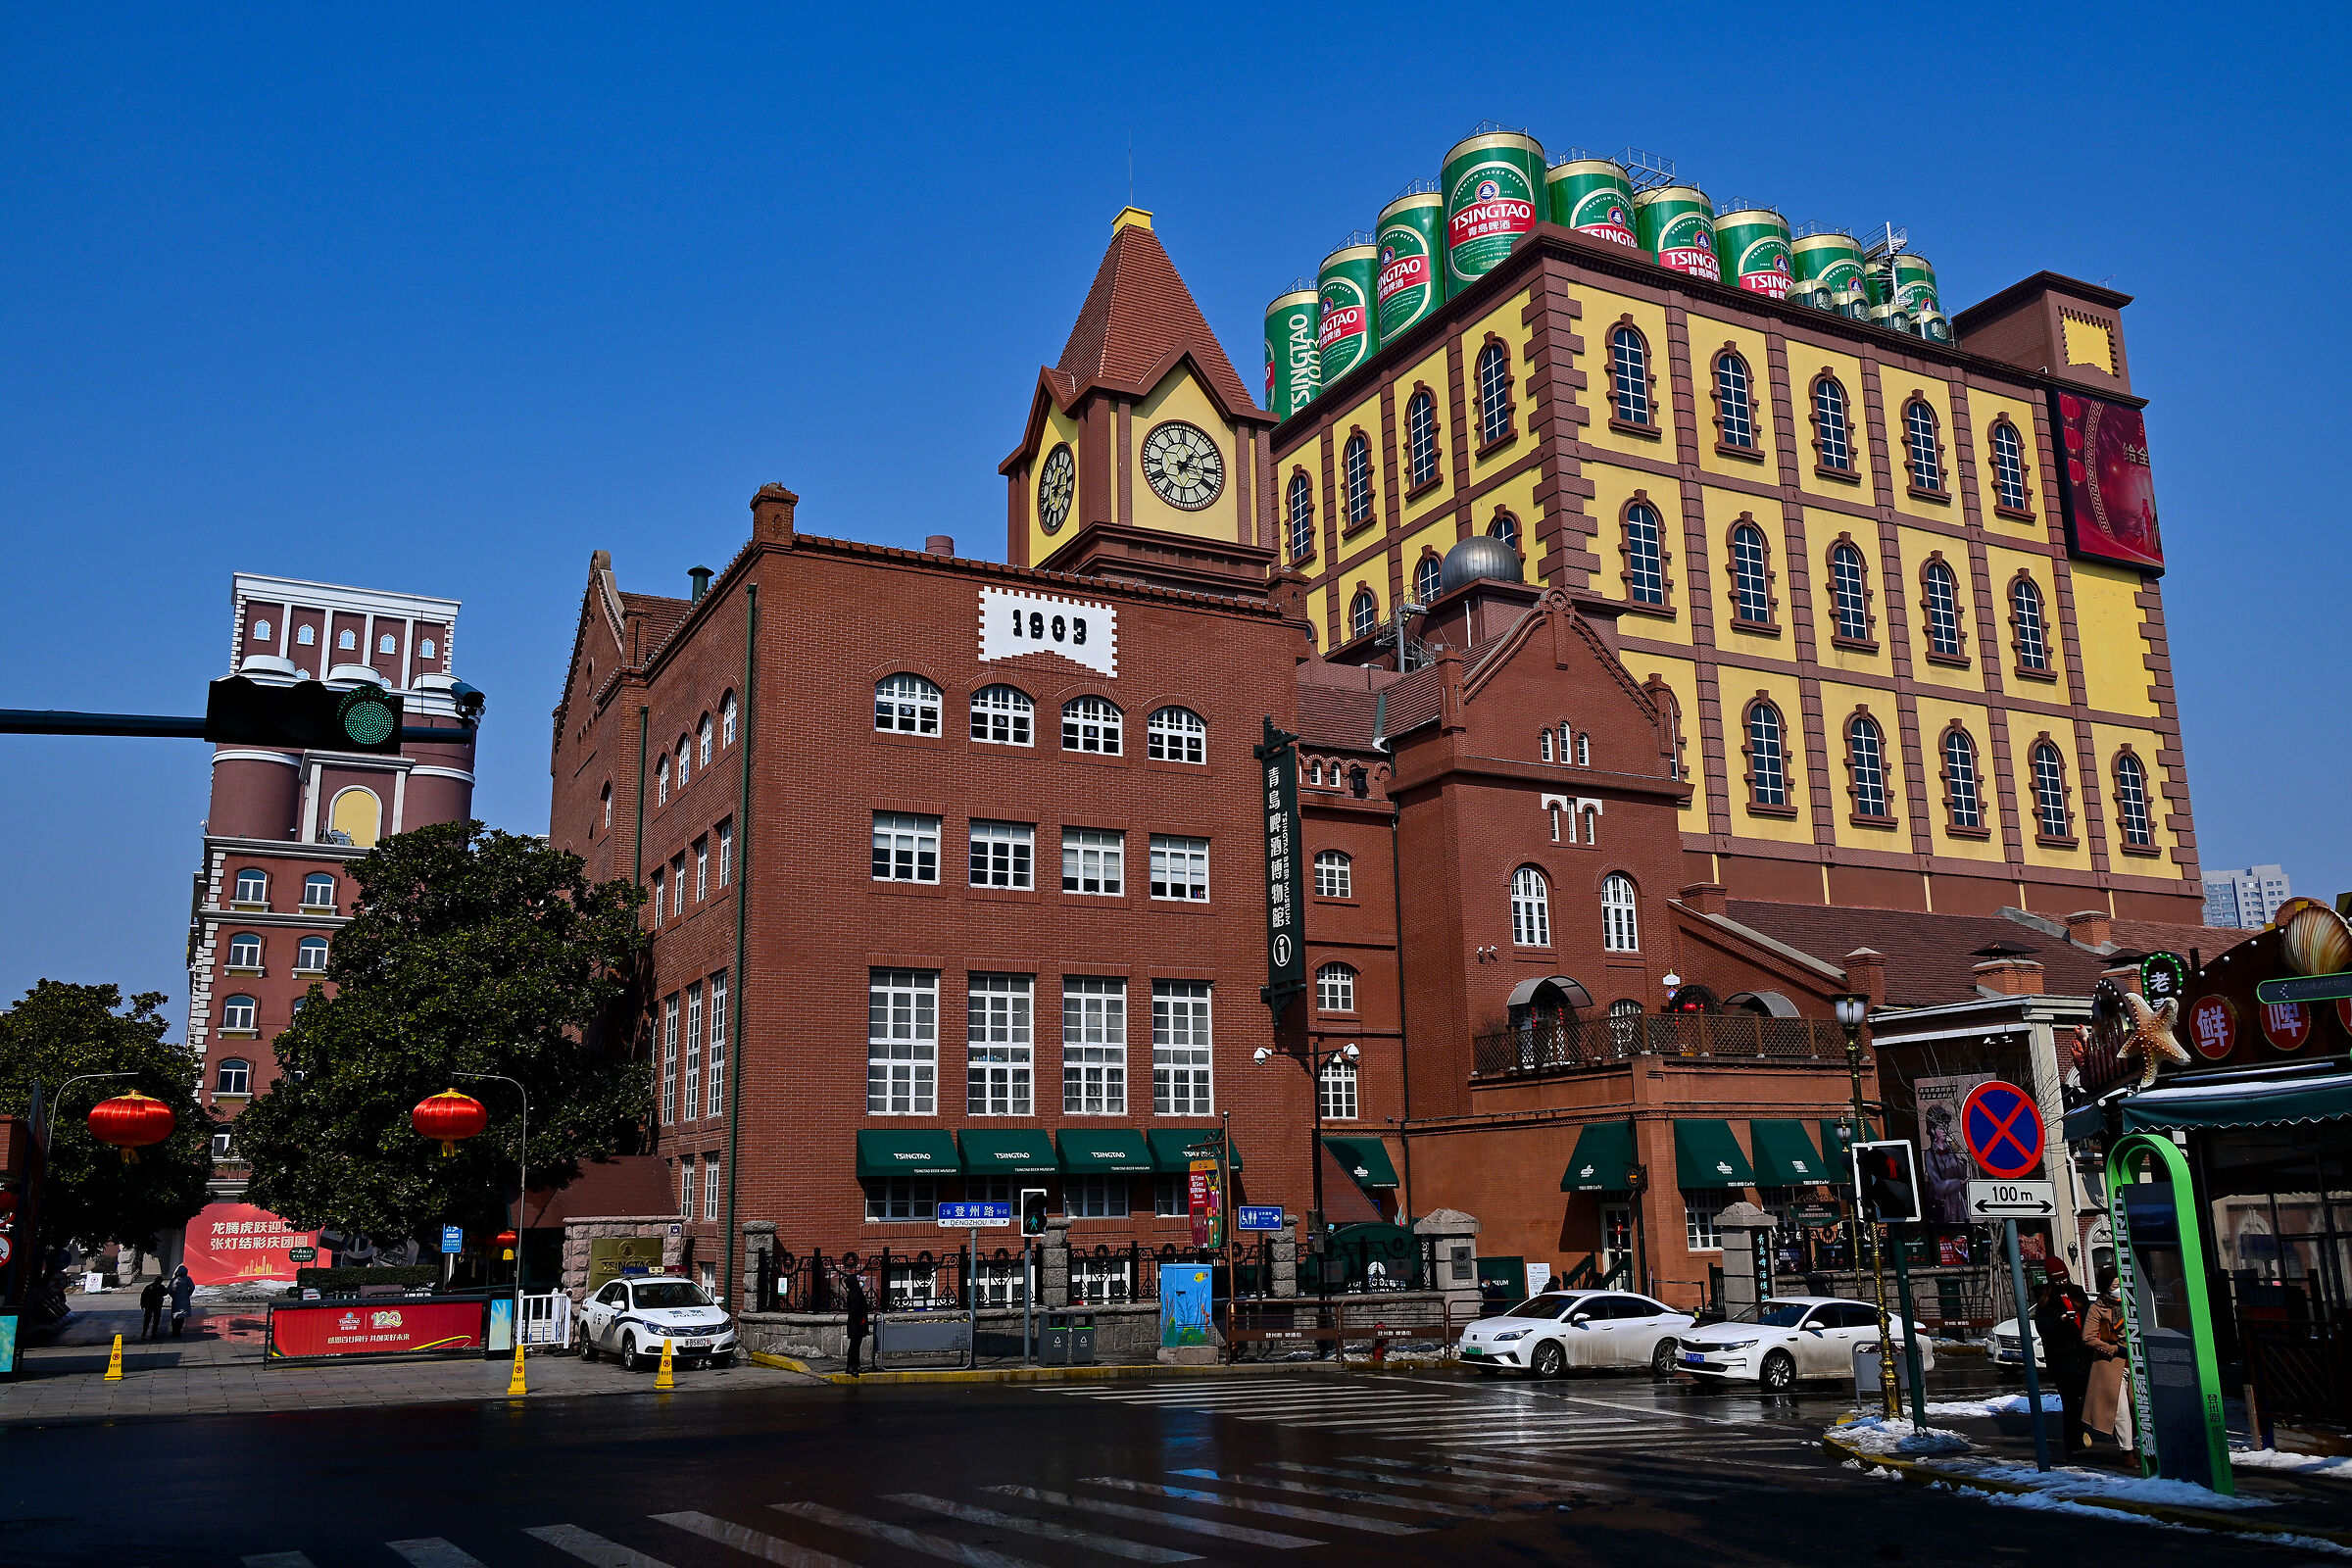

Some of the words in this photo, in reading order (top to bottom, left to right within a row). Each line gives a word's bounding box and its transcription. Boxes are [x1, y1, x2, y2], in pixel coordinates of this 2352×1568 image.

[1452, 203, 1531, 231] TSINGTAO
[1467, 220, 1511, 238] 青岛啤酒
[1579, 228, 1638, 250] TSINGTA
[1377, 259, 1421, 289] INGTAO
[1666, 250, 1720, 275] TSINGTA
[1318, 309, 1358, 339] NGTAO
[1012, 609, 1087, 646] 1903
[1267, 766, 1286, 929] 青岛啤酒博物馆
[1992, 1186, 2018, 1202] 100
[2021, 1191, 2033, 1201] m
[955, 1205, 995, 1217] 登州路
[210, 1235, 309, 1250] 张灯结彩庆团圆
